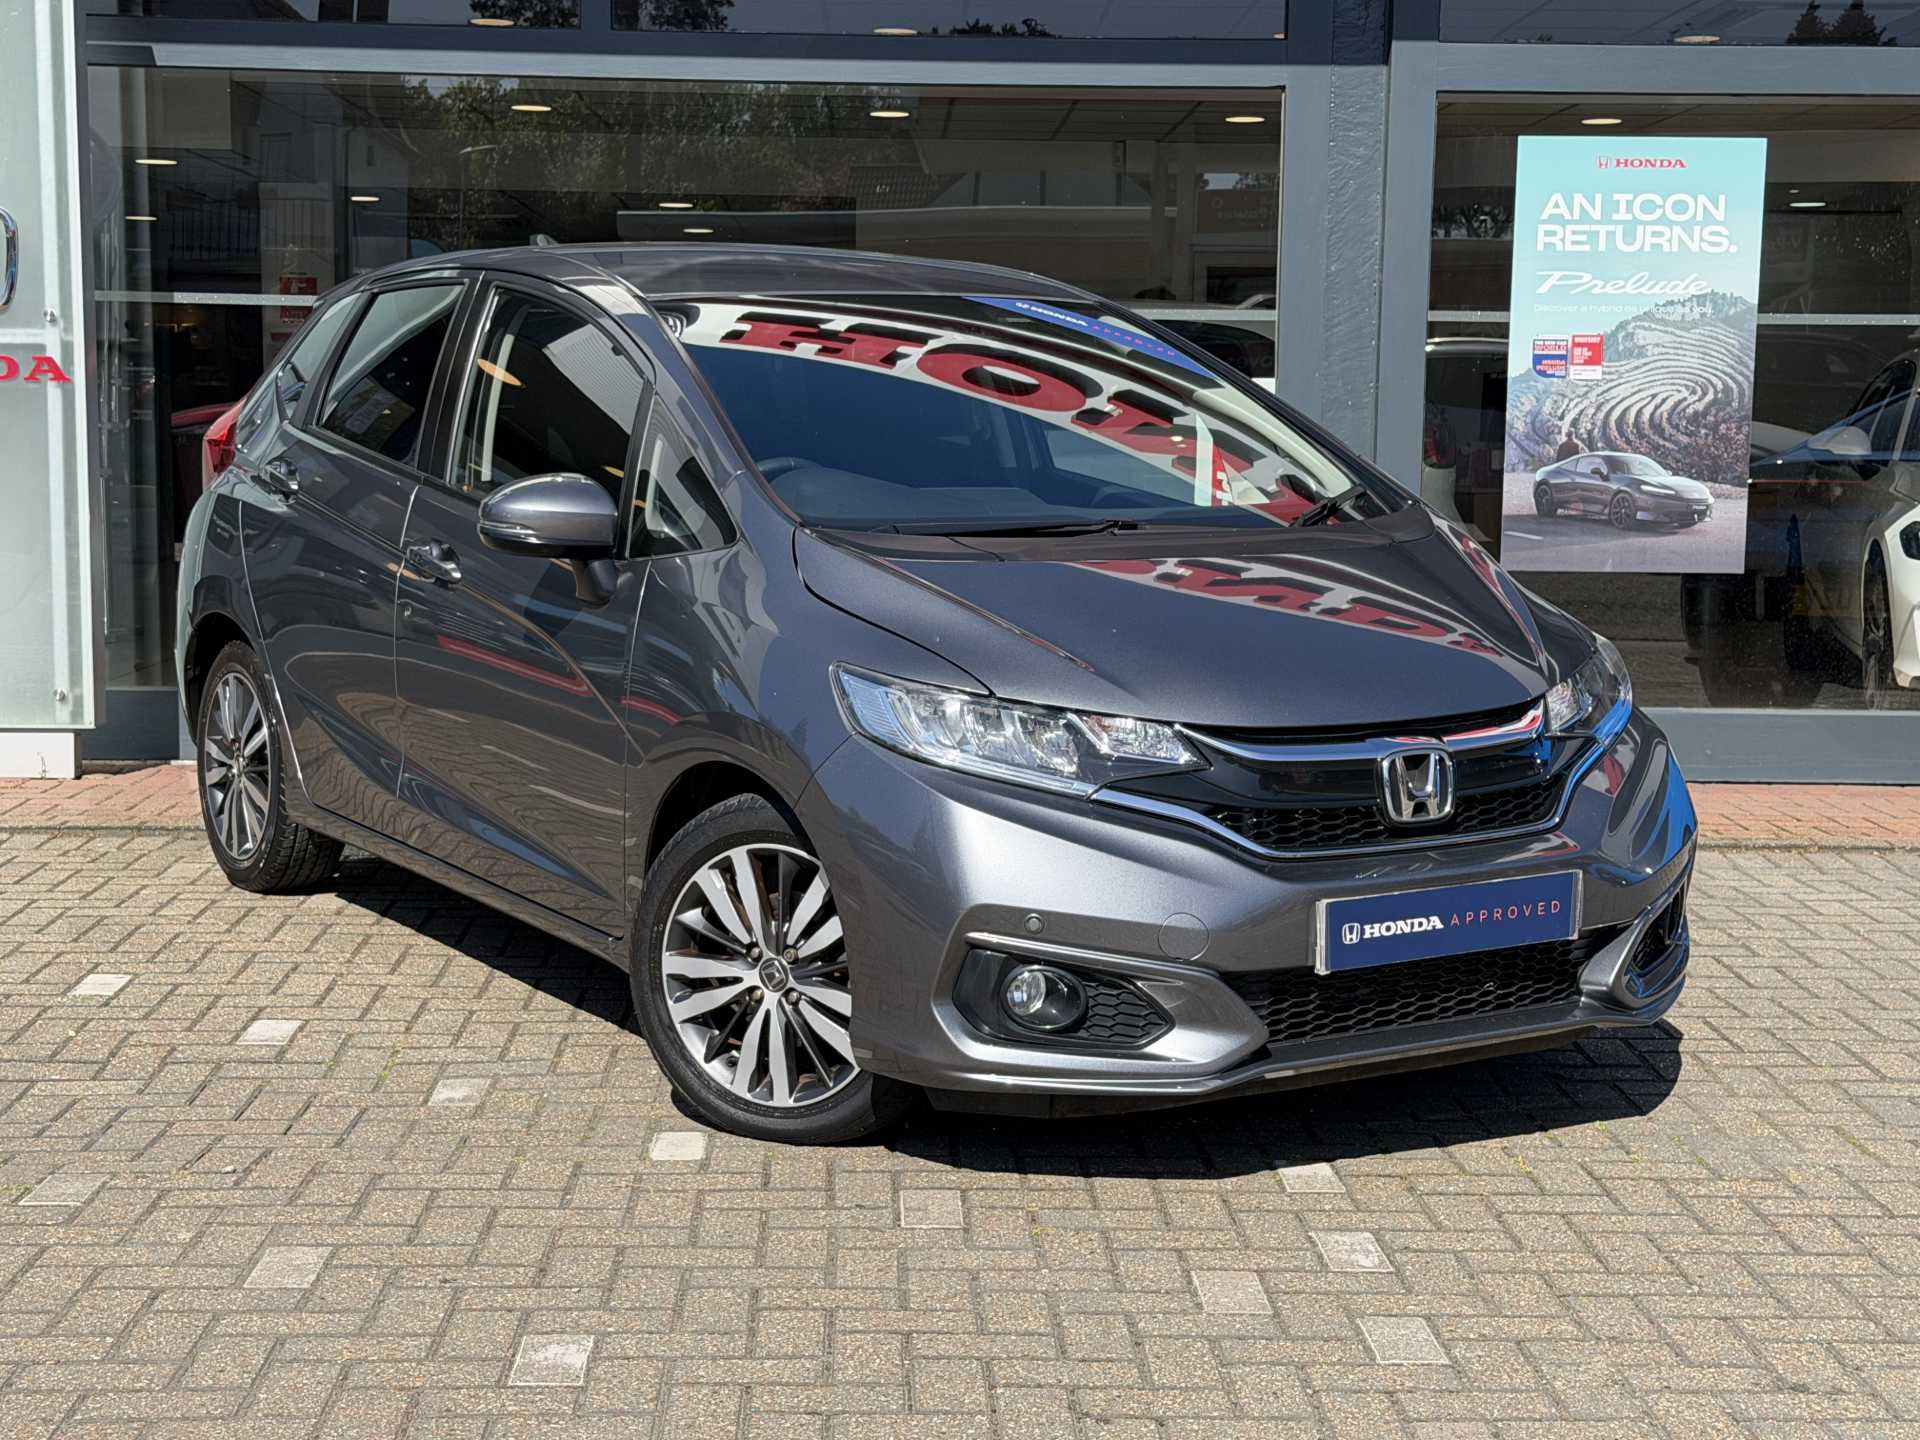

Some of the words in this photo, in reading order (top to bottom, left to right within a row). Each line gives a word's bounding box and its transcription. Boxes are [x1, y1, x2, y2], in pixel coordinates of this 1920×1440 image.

[1615, 158, 1687, 169] HONDA
[1540, 192, 1602, 221] AN
[1611, 192, 1726, 222] ICON
[1536, 223, 1739, 254] RETURNS.
[1535, 270, 1709, 295] Prelude
[1363, 915, 1445, 939] HONDA
[1450, 900, 1561, 927] APPROVED
